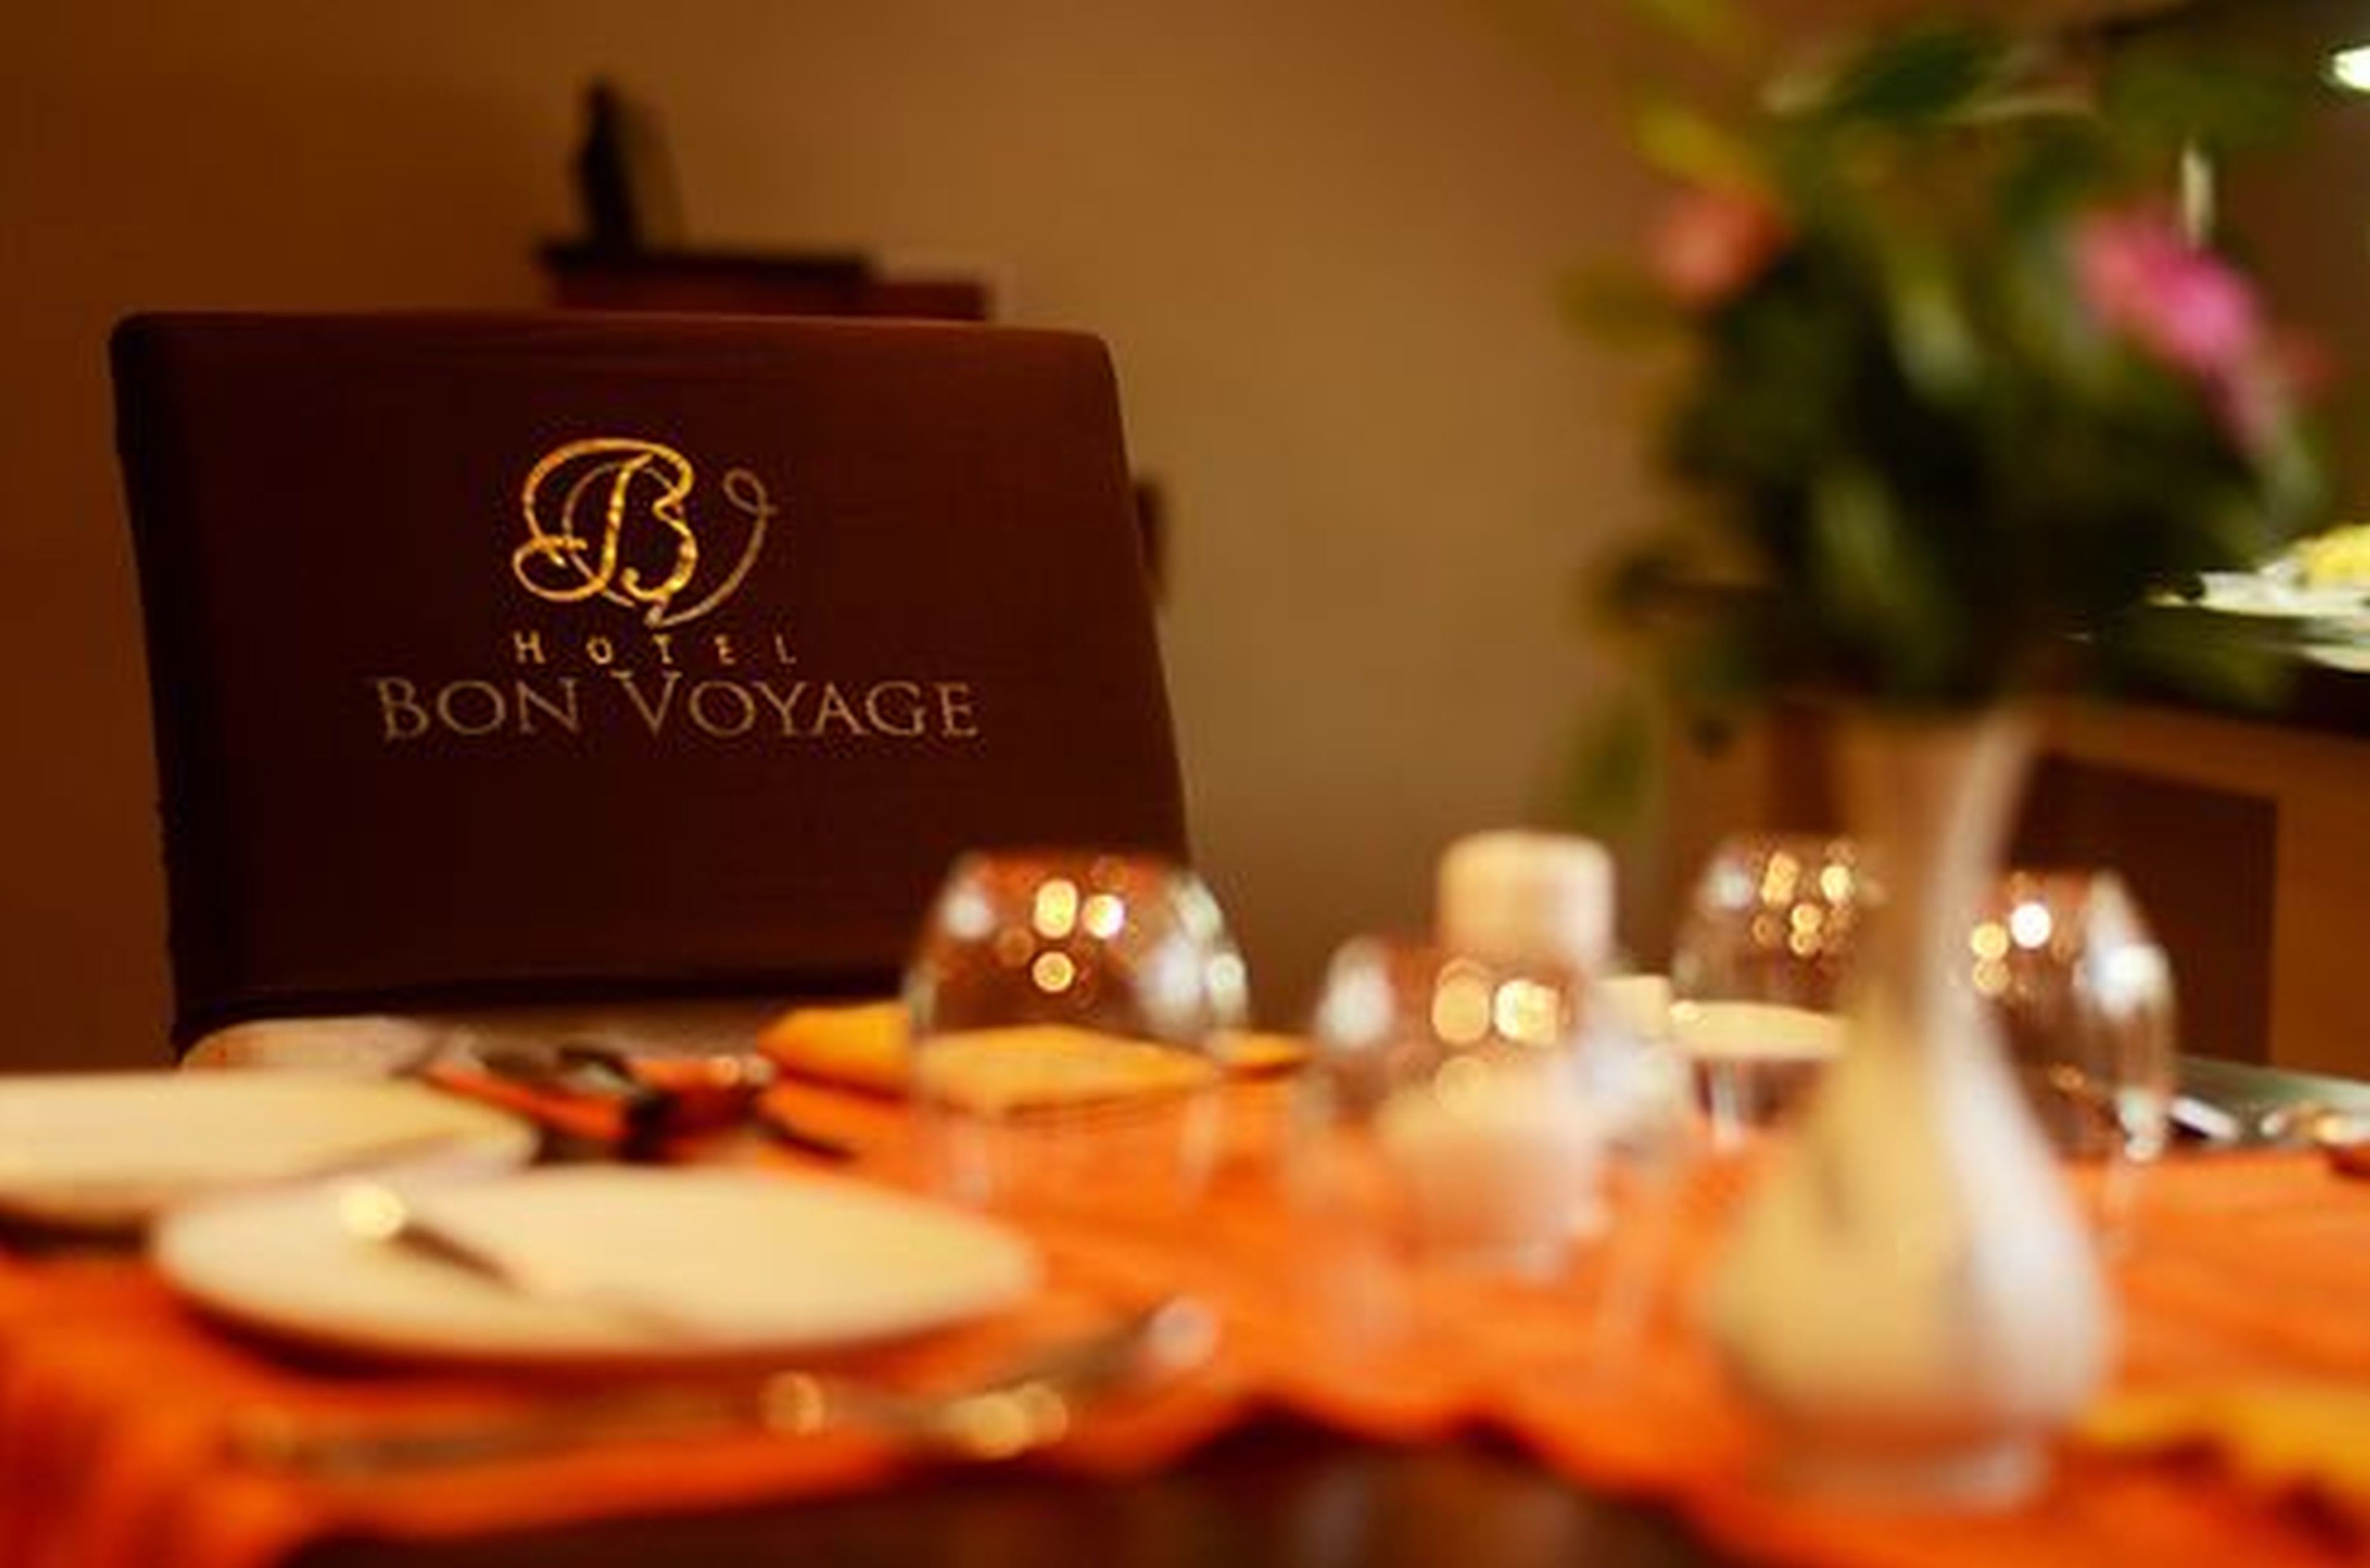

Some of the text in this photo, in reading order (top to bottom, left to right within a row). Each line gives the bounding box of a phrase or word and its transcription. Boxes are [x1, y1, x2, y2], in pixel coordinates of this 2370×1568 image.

[514, 631, 797, 665] HOTEL
[375, 671, 979, 739] BON VOYAGE
